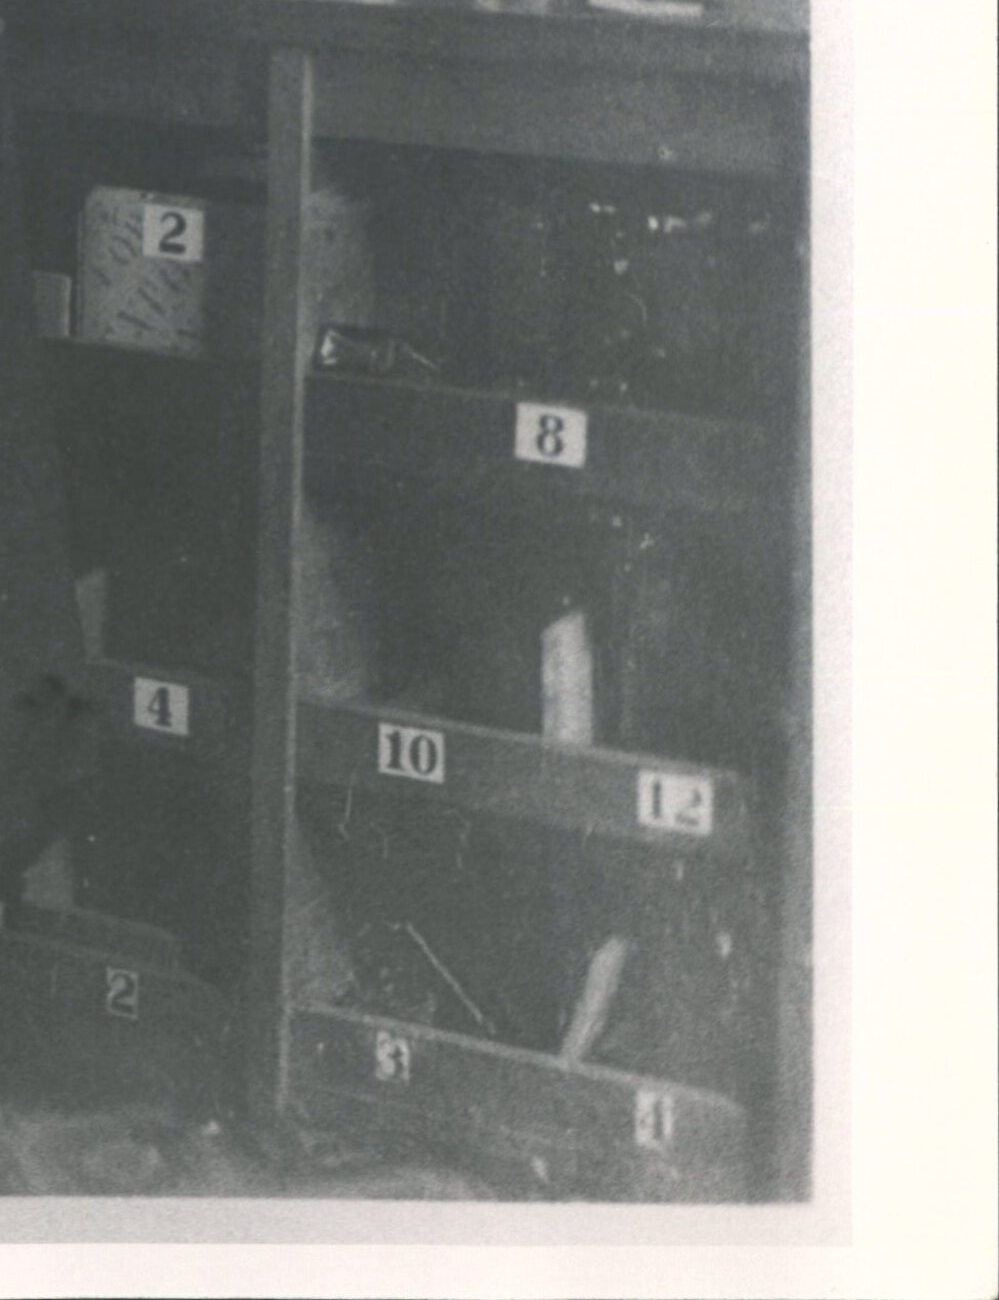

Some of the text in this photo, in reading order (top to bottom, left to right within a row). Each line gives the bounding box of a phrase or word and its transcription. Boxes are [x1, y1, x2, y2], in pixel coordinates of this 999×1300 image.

[157, 211, 187, 255] 2
[536, 413, 565, 457] 8
[147, 686, 173, 729] 4
[385, 730, 437, 777] 10
[651, 780, 703, 828] 12
[107, 971, 136, 1016] 2
